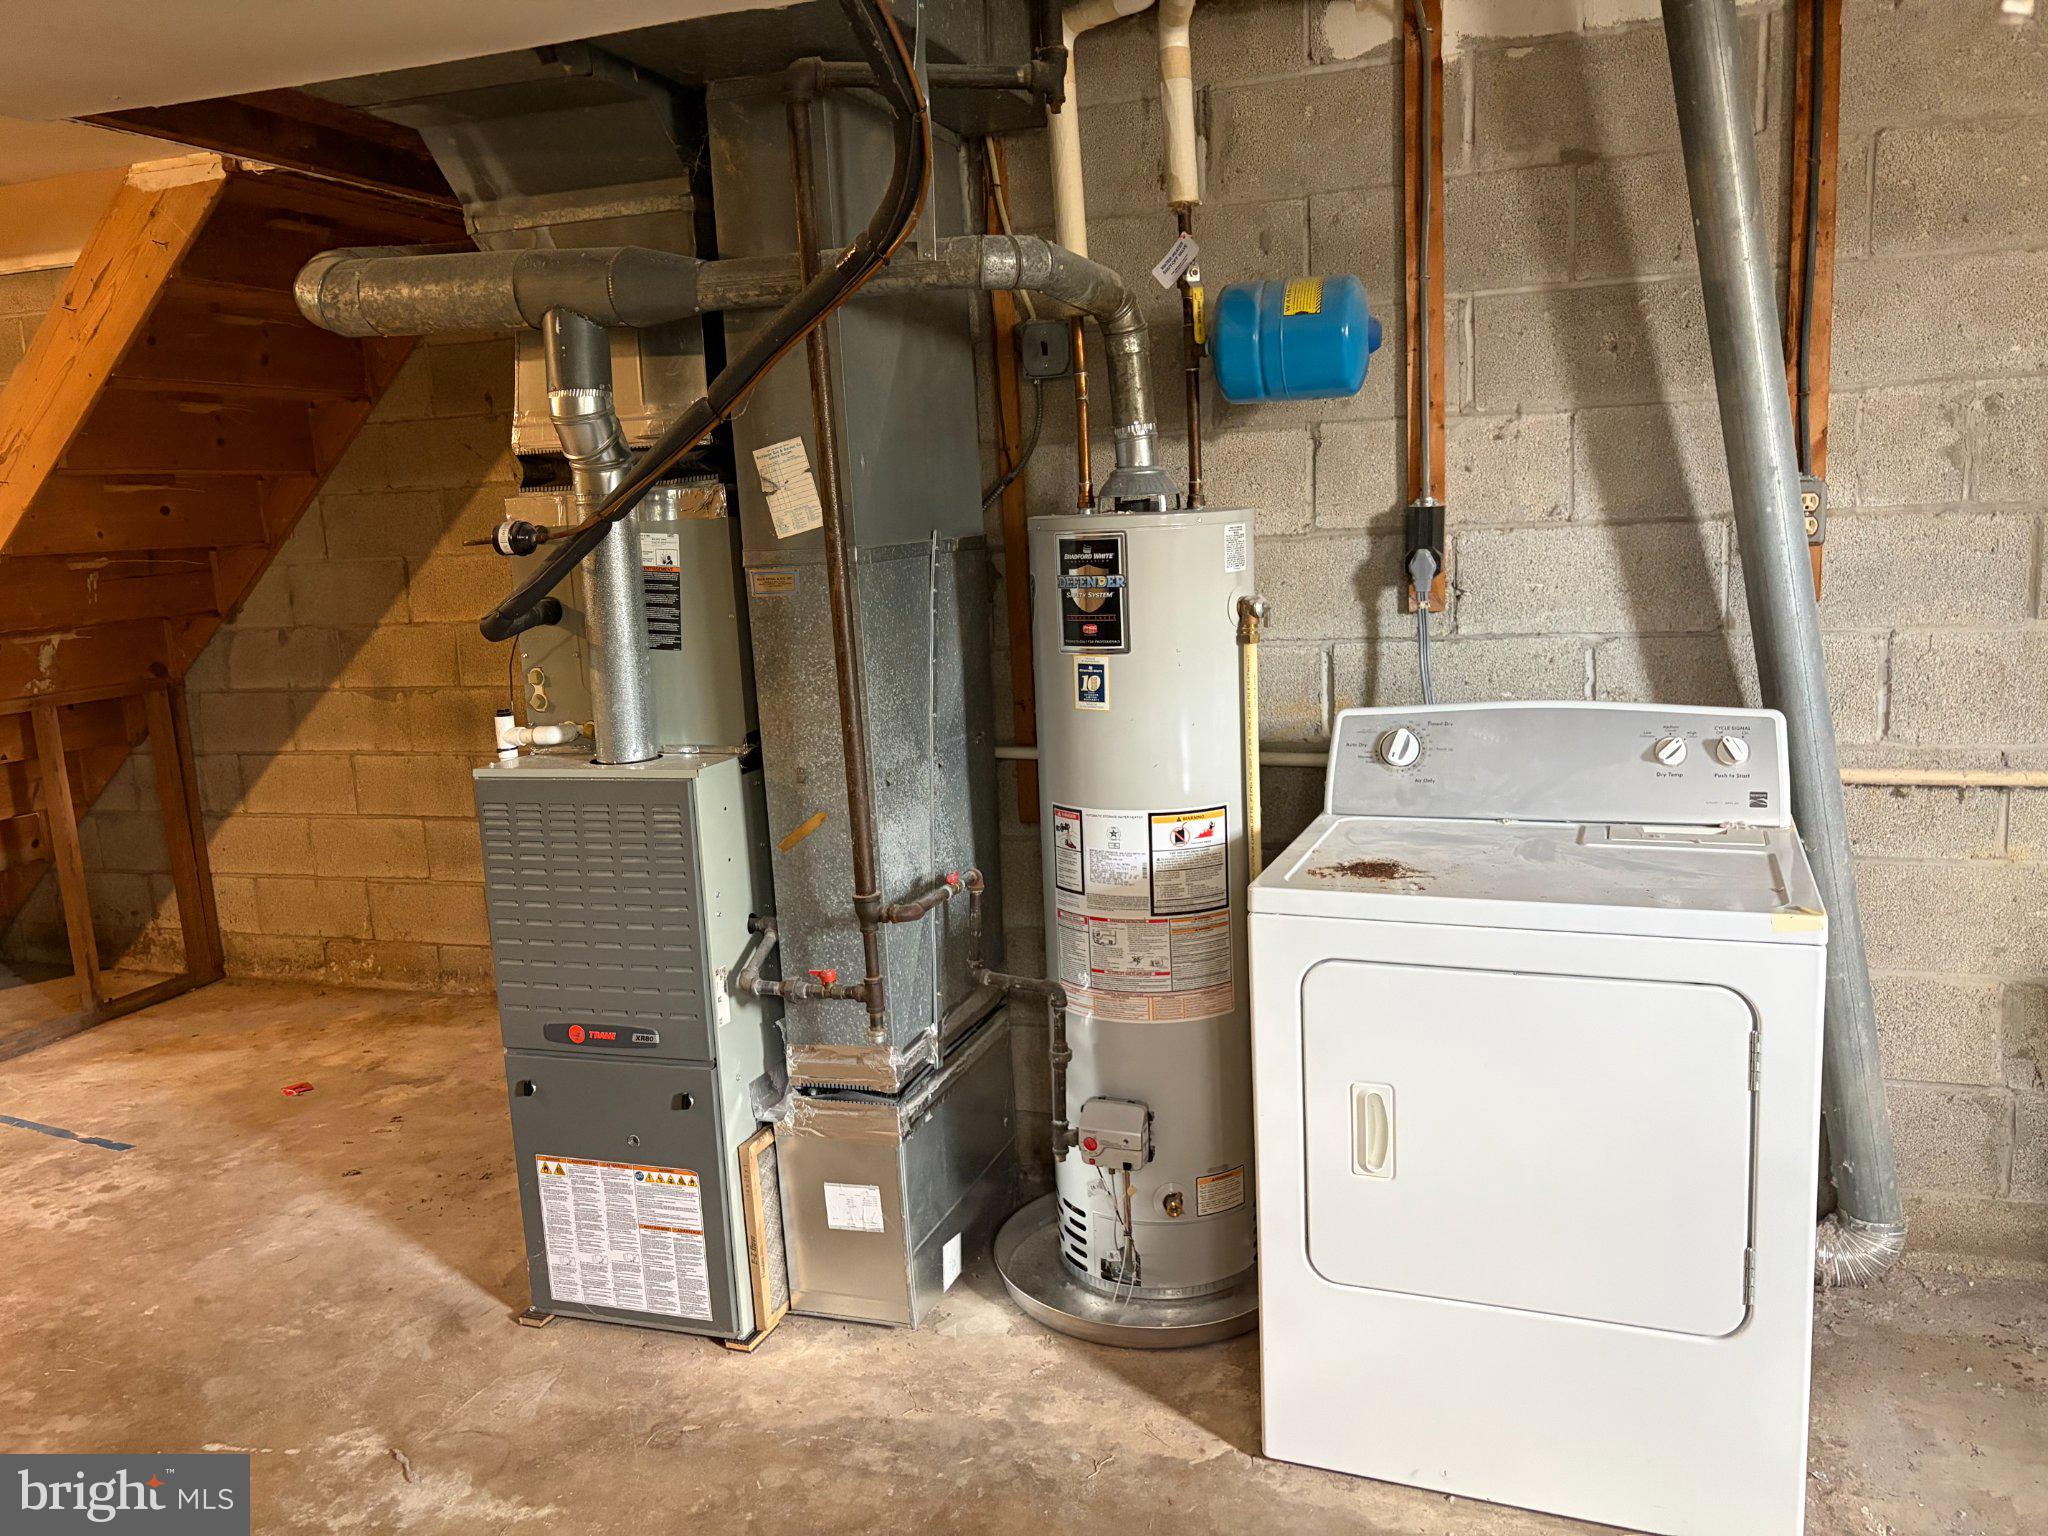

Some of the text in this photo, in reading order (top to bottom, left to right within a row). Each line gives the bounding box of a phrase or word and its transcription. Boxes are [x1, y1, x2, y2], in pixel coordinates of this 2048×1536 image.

[1057, 575, 1126, 589] DEFENDER
[1080, 675, 1101, 692] 10
[635, 1034, 654, 1042] XR80
